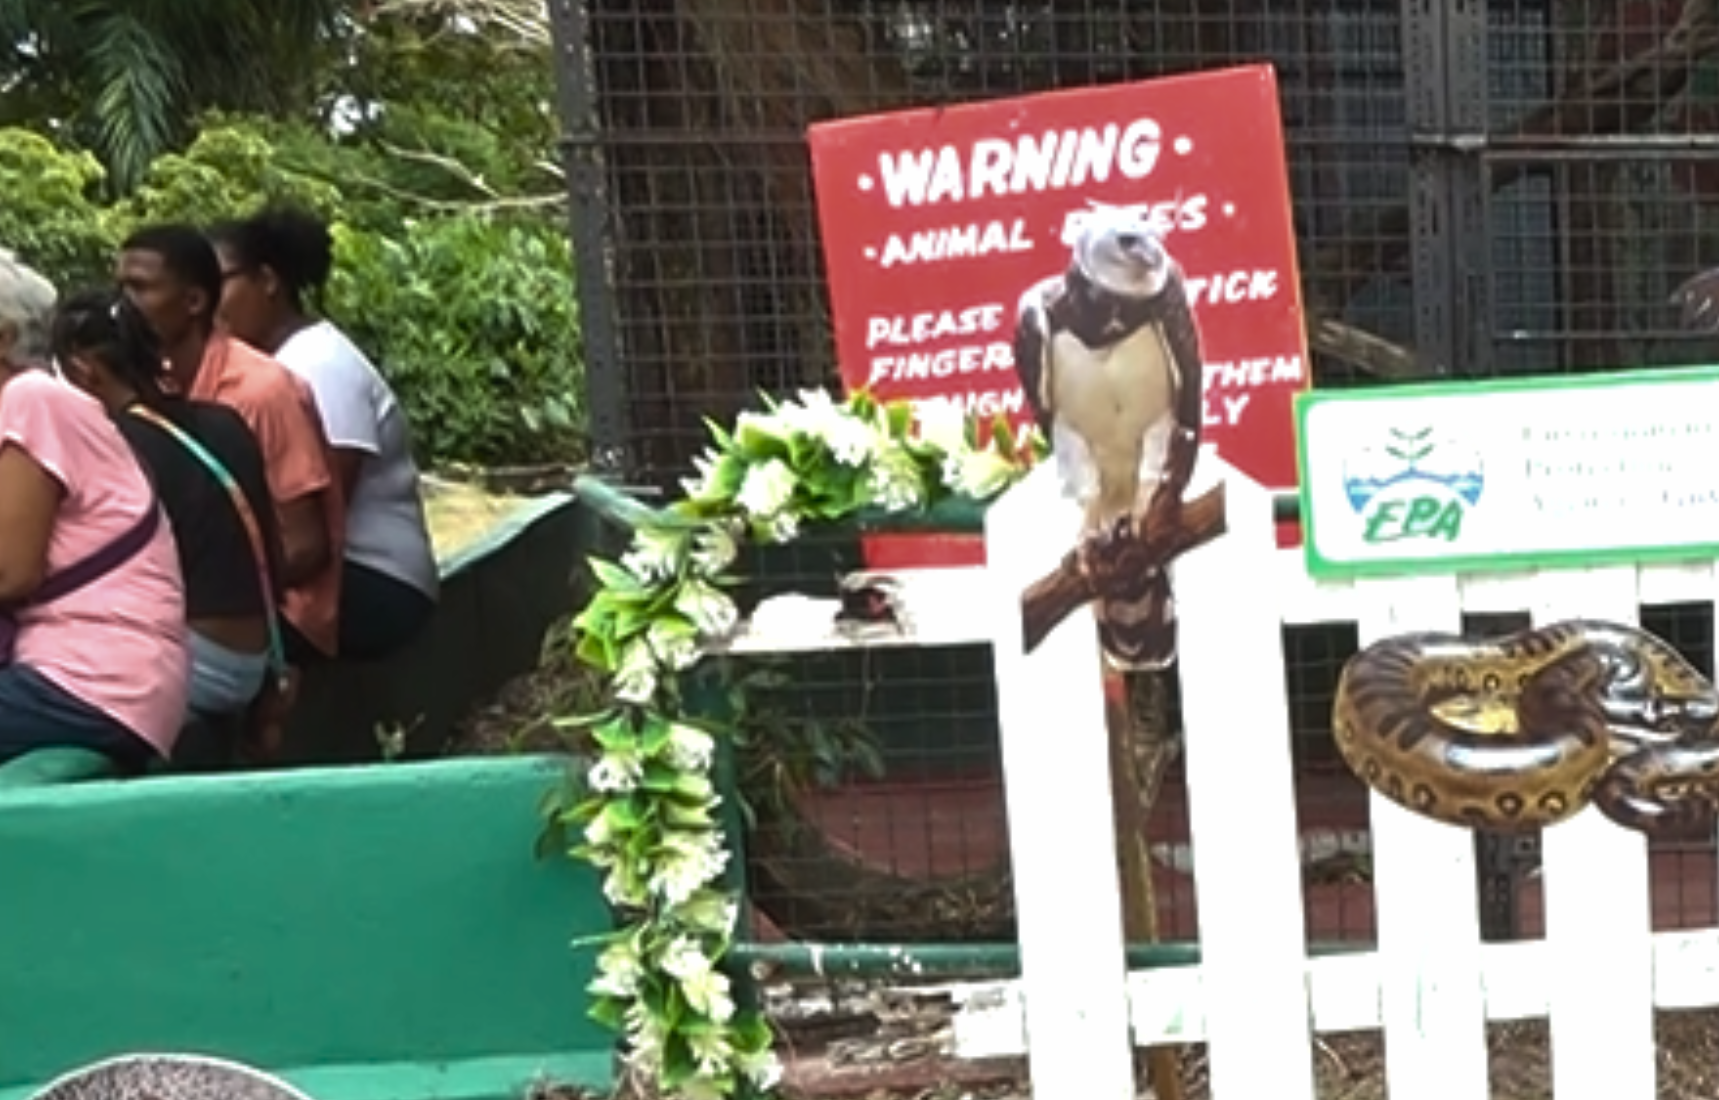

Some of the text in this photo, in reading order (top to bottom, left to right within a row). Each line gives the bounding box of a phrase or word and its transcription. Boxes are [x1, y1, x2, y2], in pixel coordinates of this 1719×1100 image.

[878, 117, 1162, 208] WARNING
[880, 192, 1208, 269] ANIMAL BES
[865, 269, 1279, 350] PLEASE TICK
[868, 340, 1015, 386] FINGER
[1361, 494, 1464, 546] EPA
